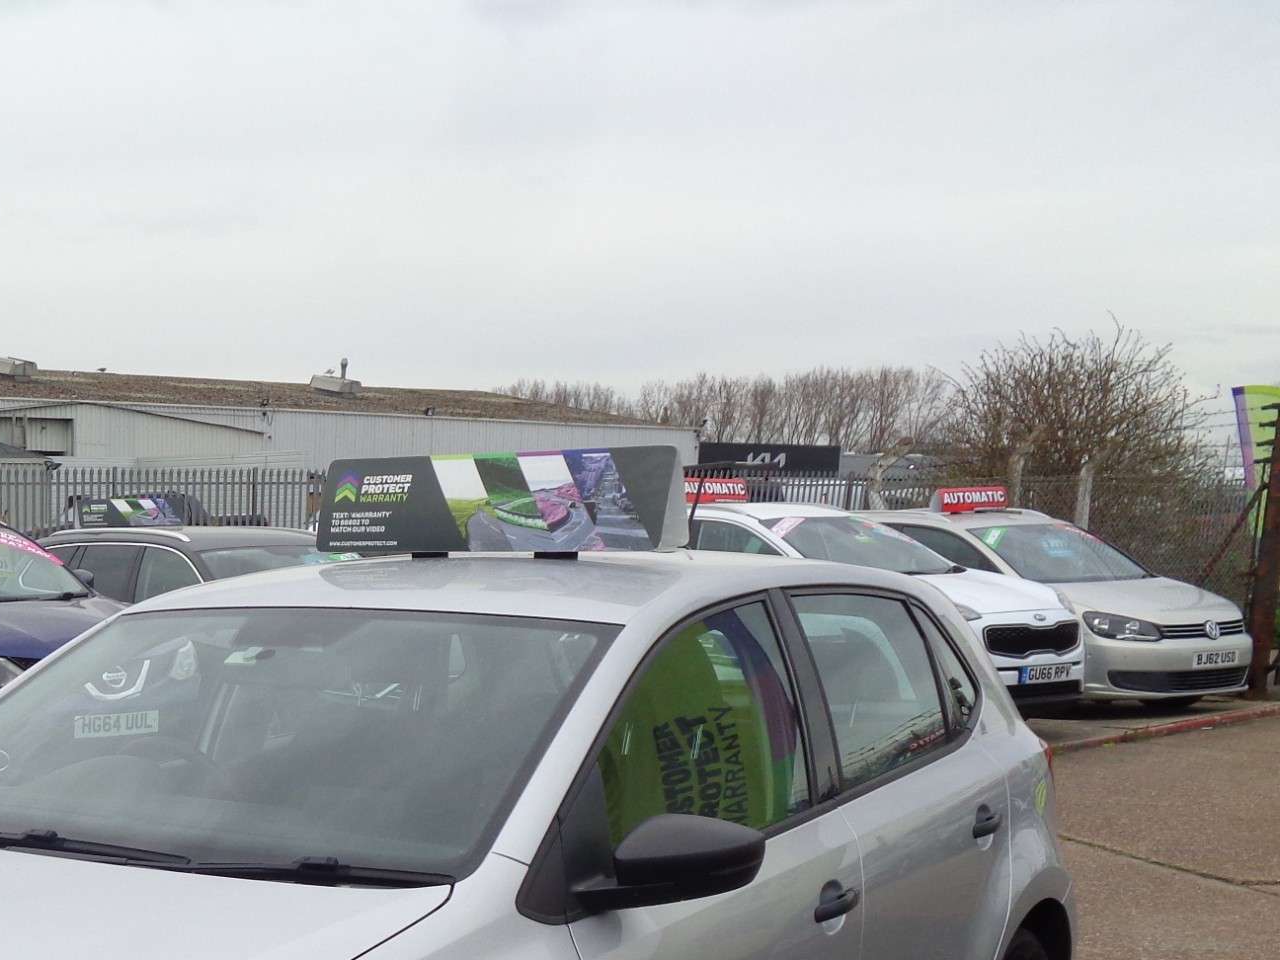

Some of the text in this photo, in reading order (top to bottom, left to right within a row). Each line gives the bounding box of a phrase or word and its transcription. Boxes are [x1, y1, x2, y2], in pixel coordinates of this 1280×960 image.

[363, 474, 412, 484] CUSTOMER
[360, 483, 411, 494] PROTECT
[684, 481, 746, 496] AUTOMATIC
[360, 493, 408, 503] WARRANTY
[943, 491, 1005, 504] AUTOMATIC
[1197, 653, 1220, 665] BJ62
[1028, 667, 1053, 680] GU66
[81, 716, 120, 734] HG64
[653, 722, 696, 815] STOMER
[674, 715, 722, 817] ROTECT
